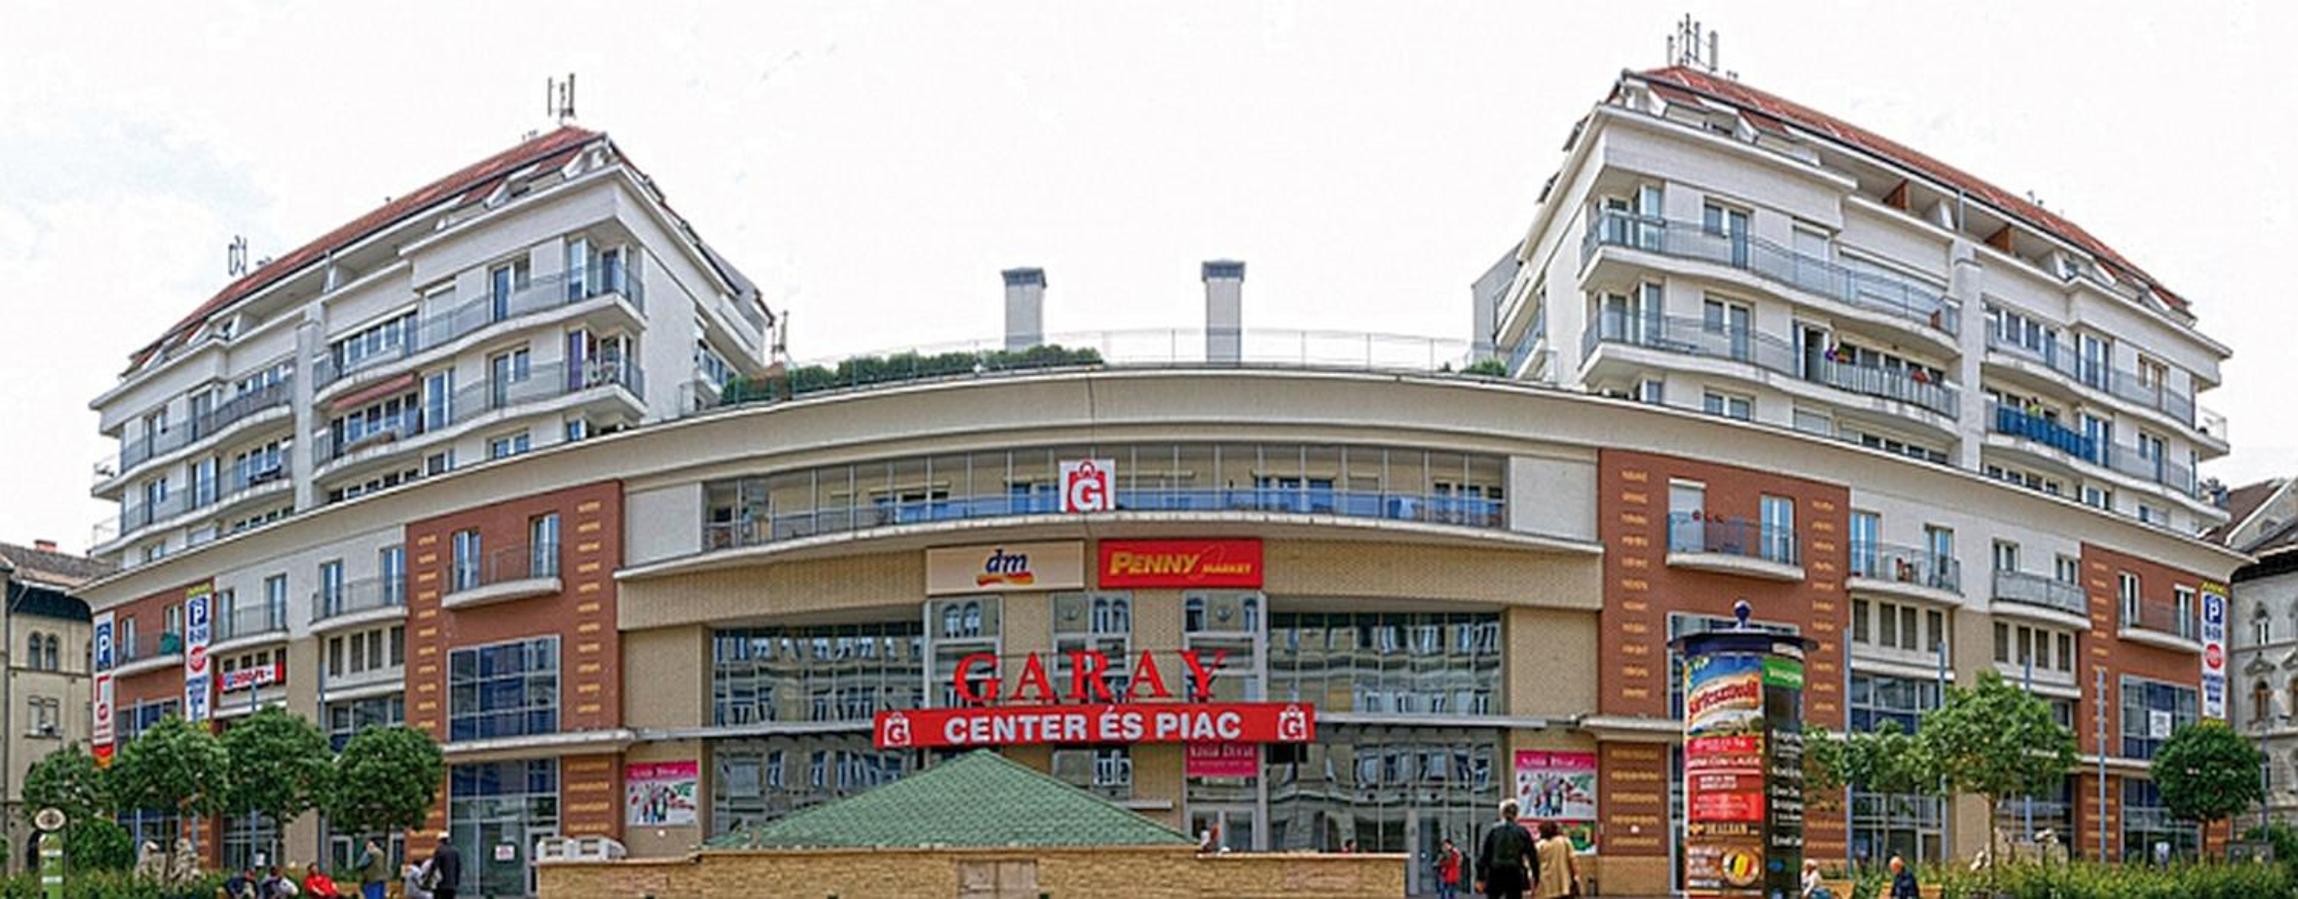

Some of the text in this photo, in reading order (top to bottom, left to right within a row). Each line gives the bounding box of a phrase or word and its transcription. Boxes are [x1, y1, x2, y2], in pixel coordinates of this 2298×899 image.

[1070, 478, 1103, 512] G
[985, 549, 1028, 574] dm
[1109, 552, 1251, 575] PENNY MARKET
[953, 648, 1228, 703] GARAY
[944, 714, 1087, 743] CENTER
[1099, 704, 1144, 740] ÉS
[1155, 711, 1242, 739] PIAC
